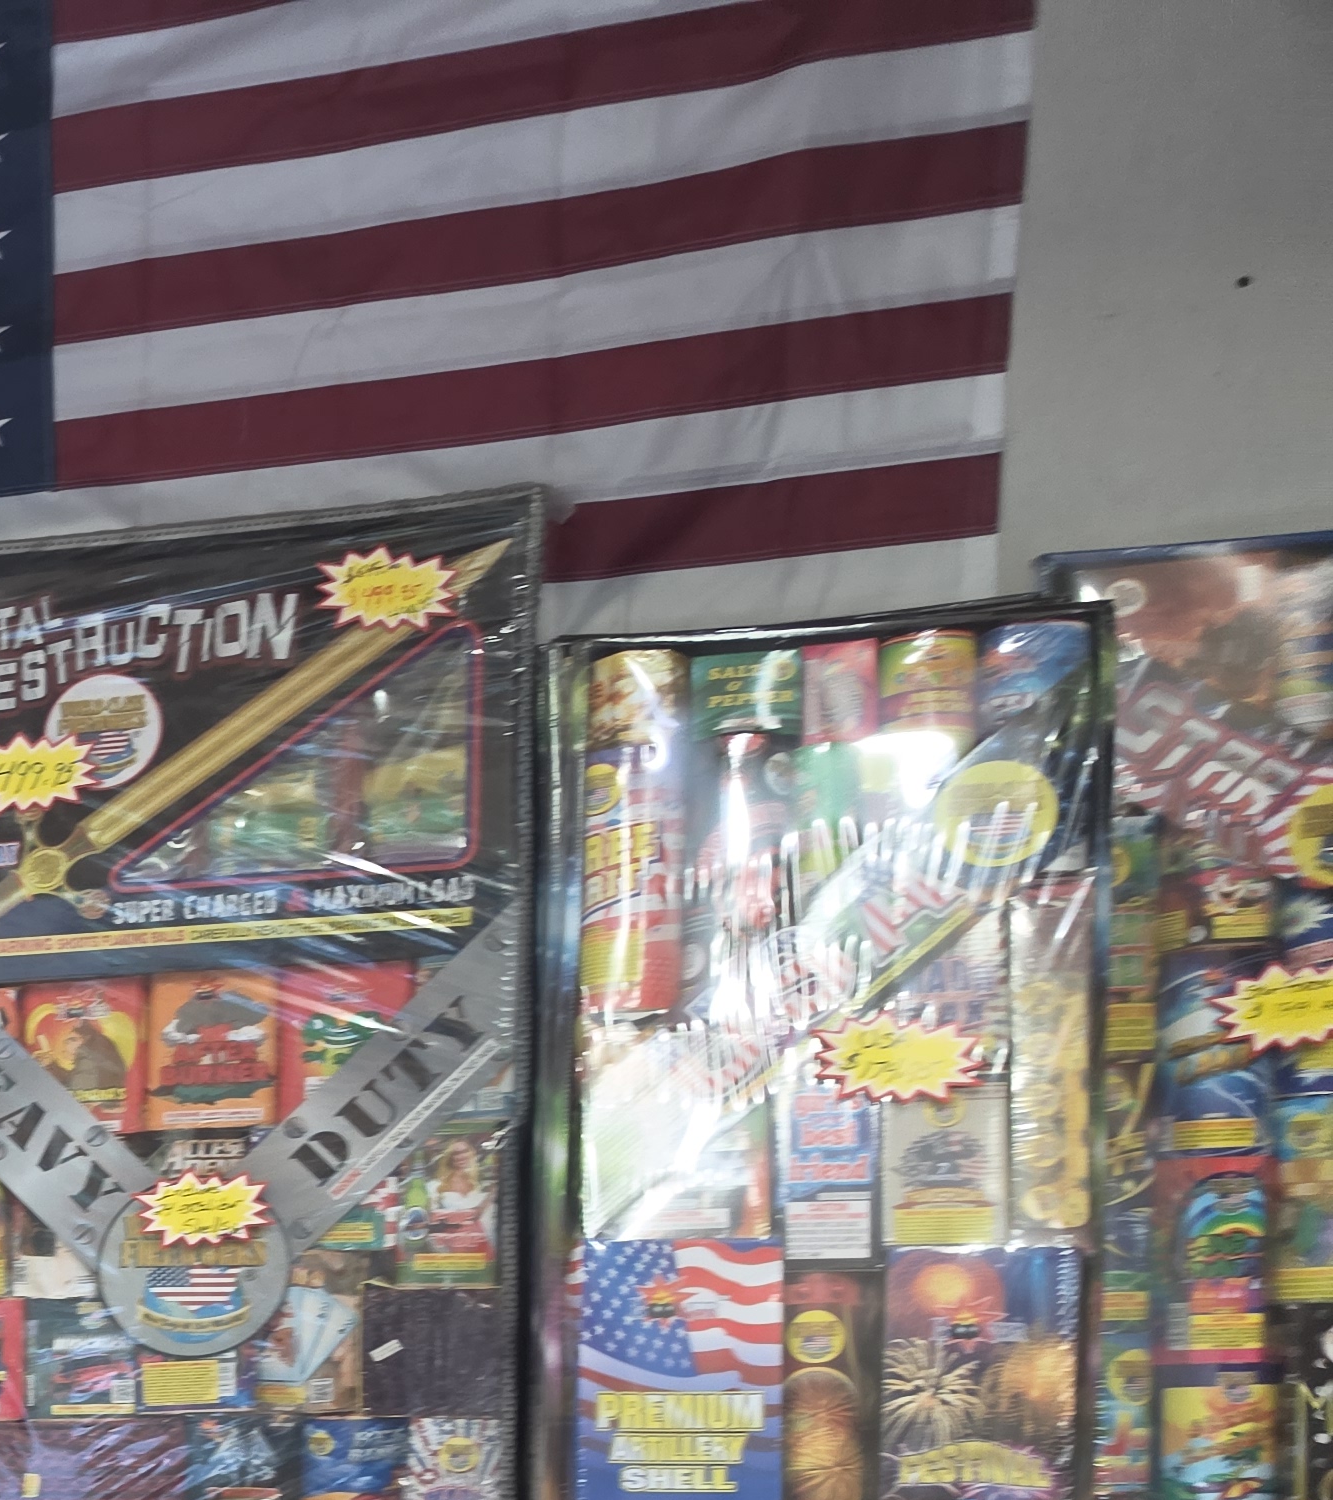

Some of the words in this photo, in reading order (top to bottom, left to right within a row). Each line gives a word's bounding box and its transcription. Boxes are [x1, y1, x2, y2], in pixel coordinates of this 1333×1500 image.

[112, 900, 176, 925] SUPER
[289, 996, 488, 1189] DUTY
[595, 1391, 764, 1432] PREMIUM
[609, 1433, 749, 1464] ARTILLERY
[620, 1465, 737, 1493] SHELL
